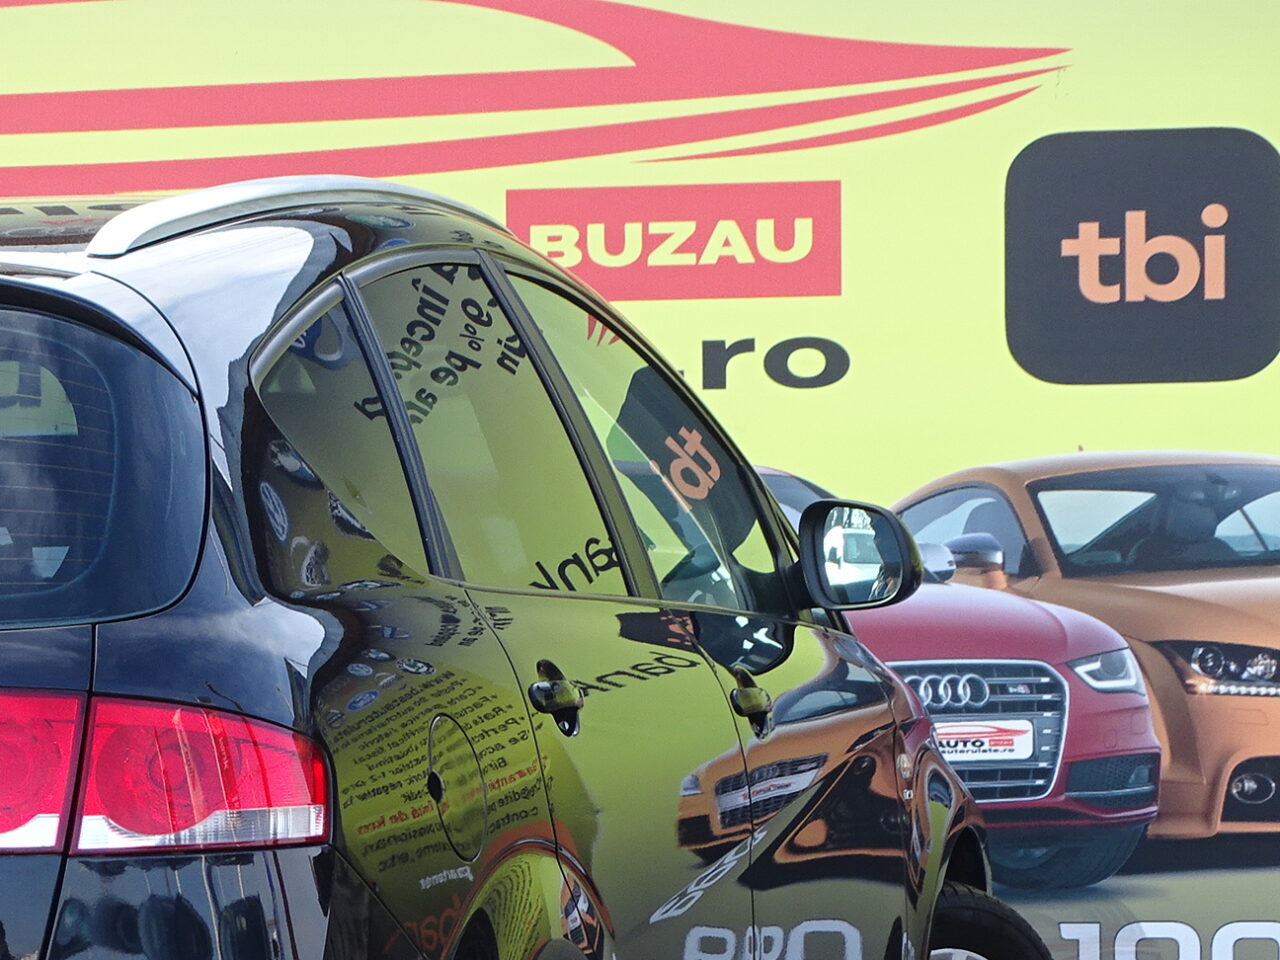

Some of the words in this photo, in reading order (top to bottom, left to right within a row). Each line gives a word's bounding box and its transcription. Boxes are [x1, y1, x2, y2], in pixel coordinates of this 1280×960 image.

[529, 217, 814, 269] BUZAU
[1061, 203, 1229, 304] tbi
[681, 336, 851, 390] ro
